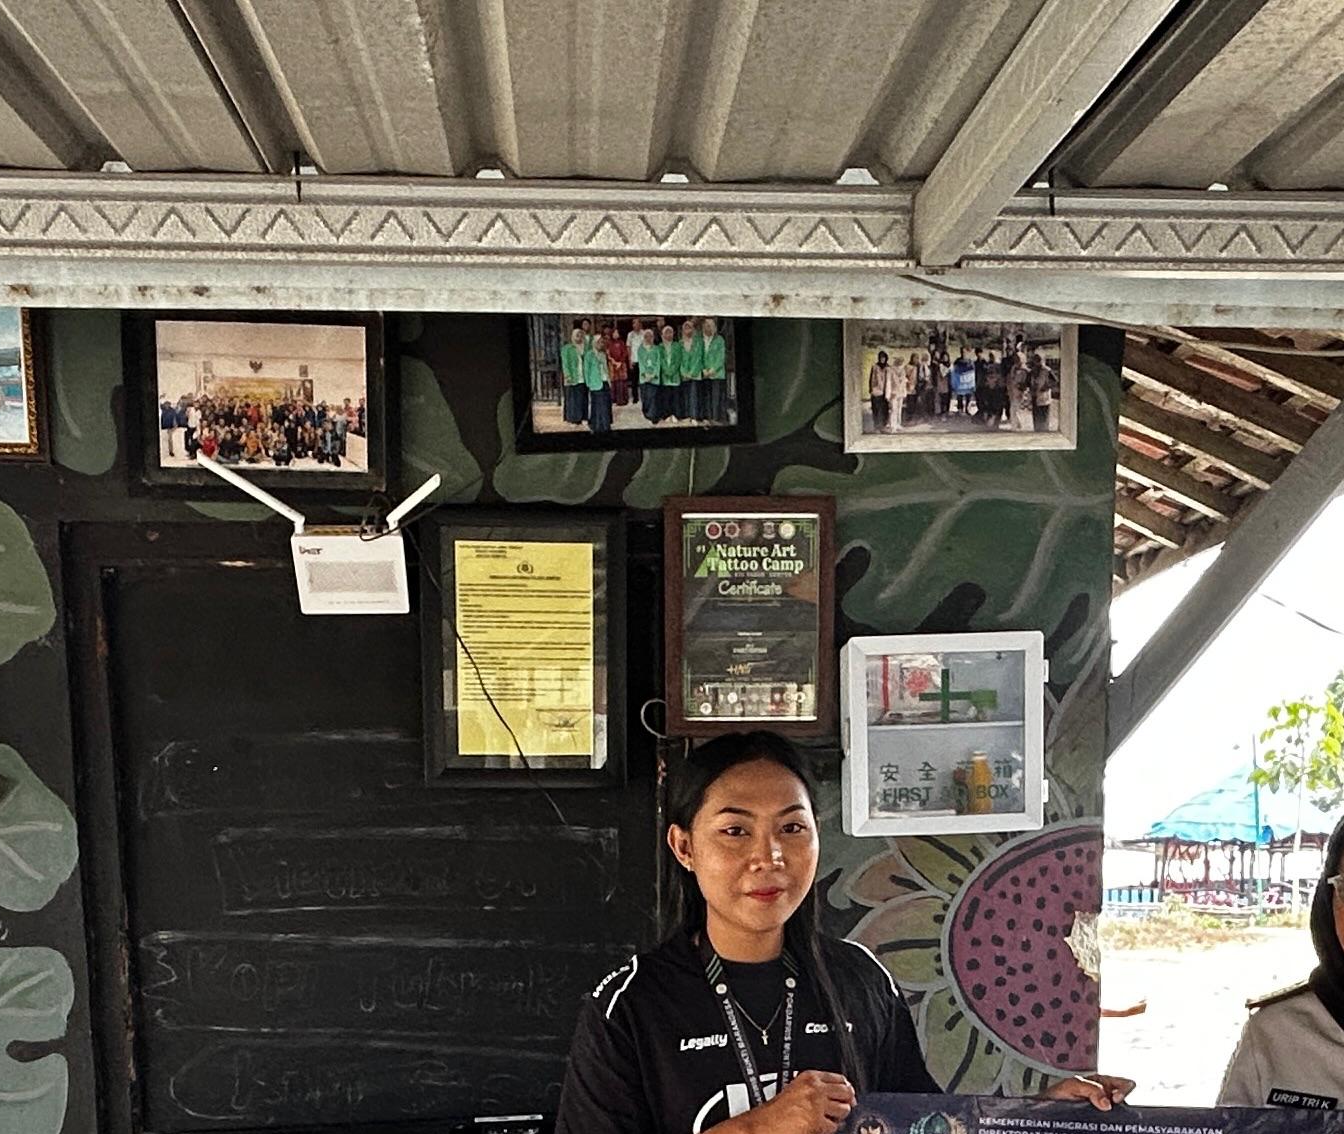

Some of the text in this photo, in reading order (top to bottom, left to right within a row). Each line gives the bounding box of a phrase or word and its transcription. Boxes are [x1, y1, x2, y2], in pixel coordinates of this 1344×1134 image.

[716, 543, 769, 558] Nature
[771, 543, 797, 558] Art
[706, 557, 804, 574] Tattoo Camp
[882, 786, 933, 804] FIRST
[975, 784, 1010, 799] BOX
[679, 1033, 729, 1052] Legally
[1272, 1092, 1300, 1104] URIP
[978, 1117, 1051, 1129] KEMENTERIAN
[1052, 1121, 1099, 1132] IMIGRASI
[1100, 1123, 1124, 1133] DAN
